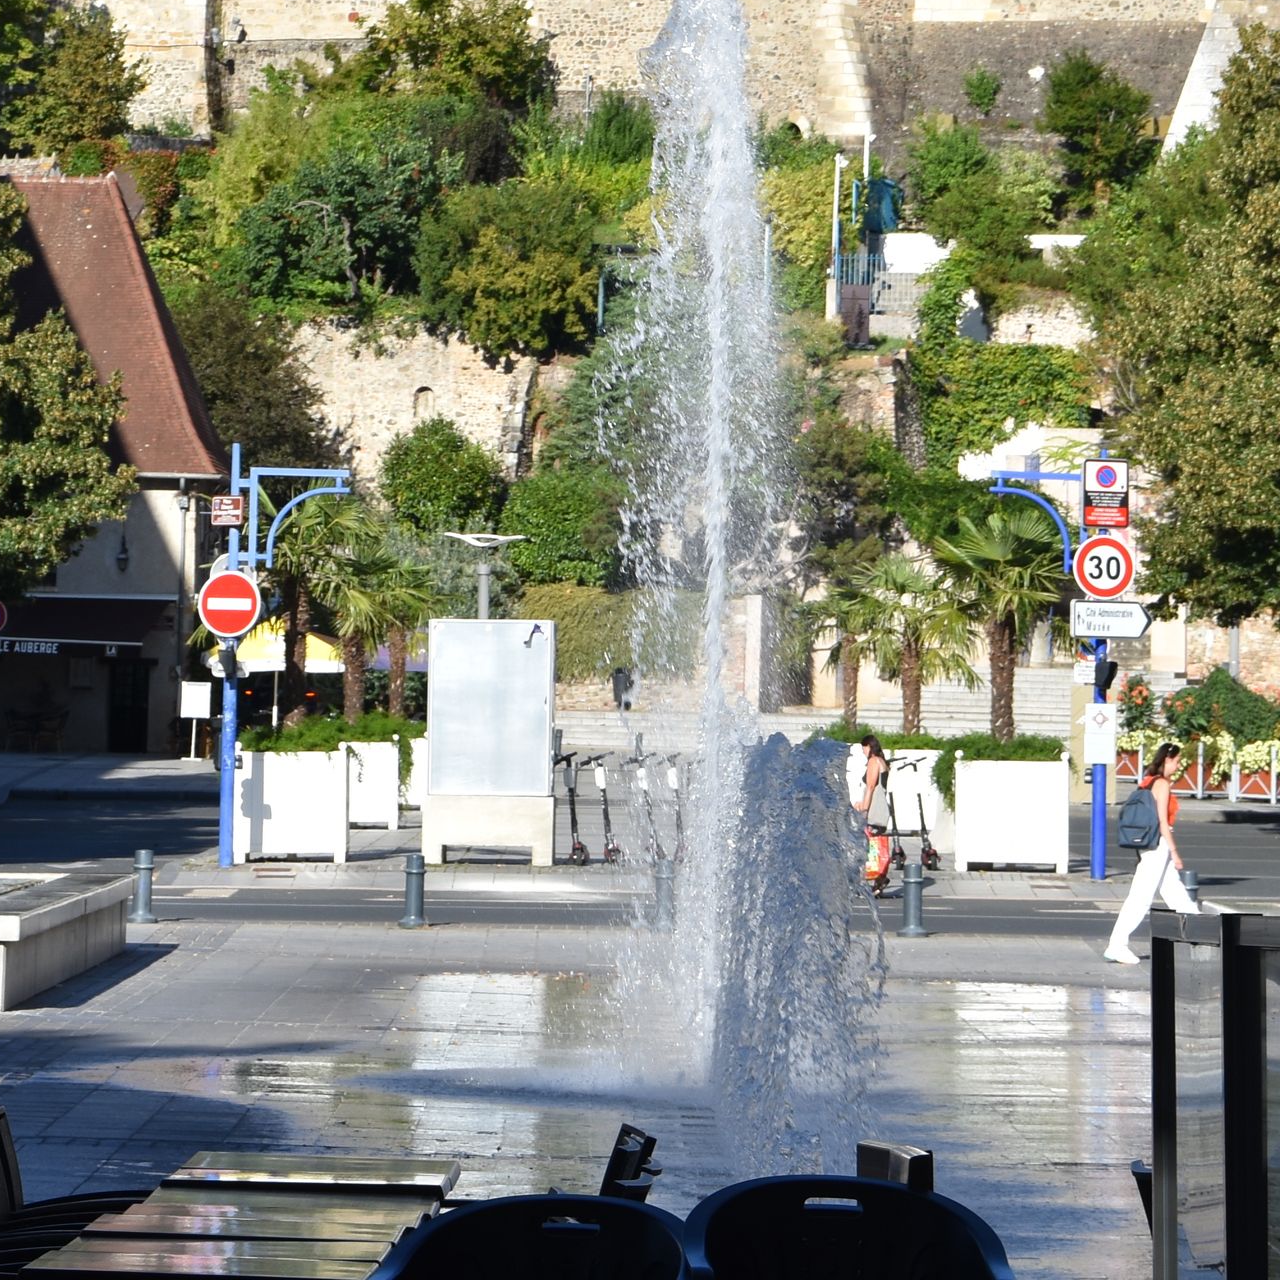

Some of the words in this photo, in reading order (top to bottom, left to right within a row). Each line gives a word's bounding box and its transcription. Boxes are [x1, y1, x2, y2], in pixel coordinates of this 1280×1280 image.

[1088, 555, 1121, 580] 30
[1098, 607, 1133, 618] Administrative
[14, 641, 59, 654] AUBERGE
